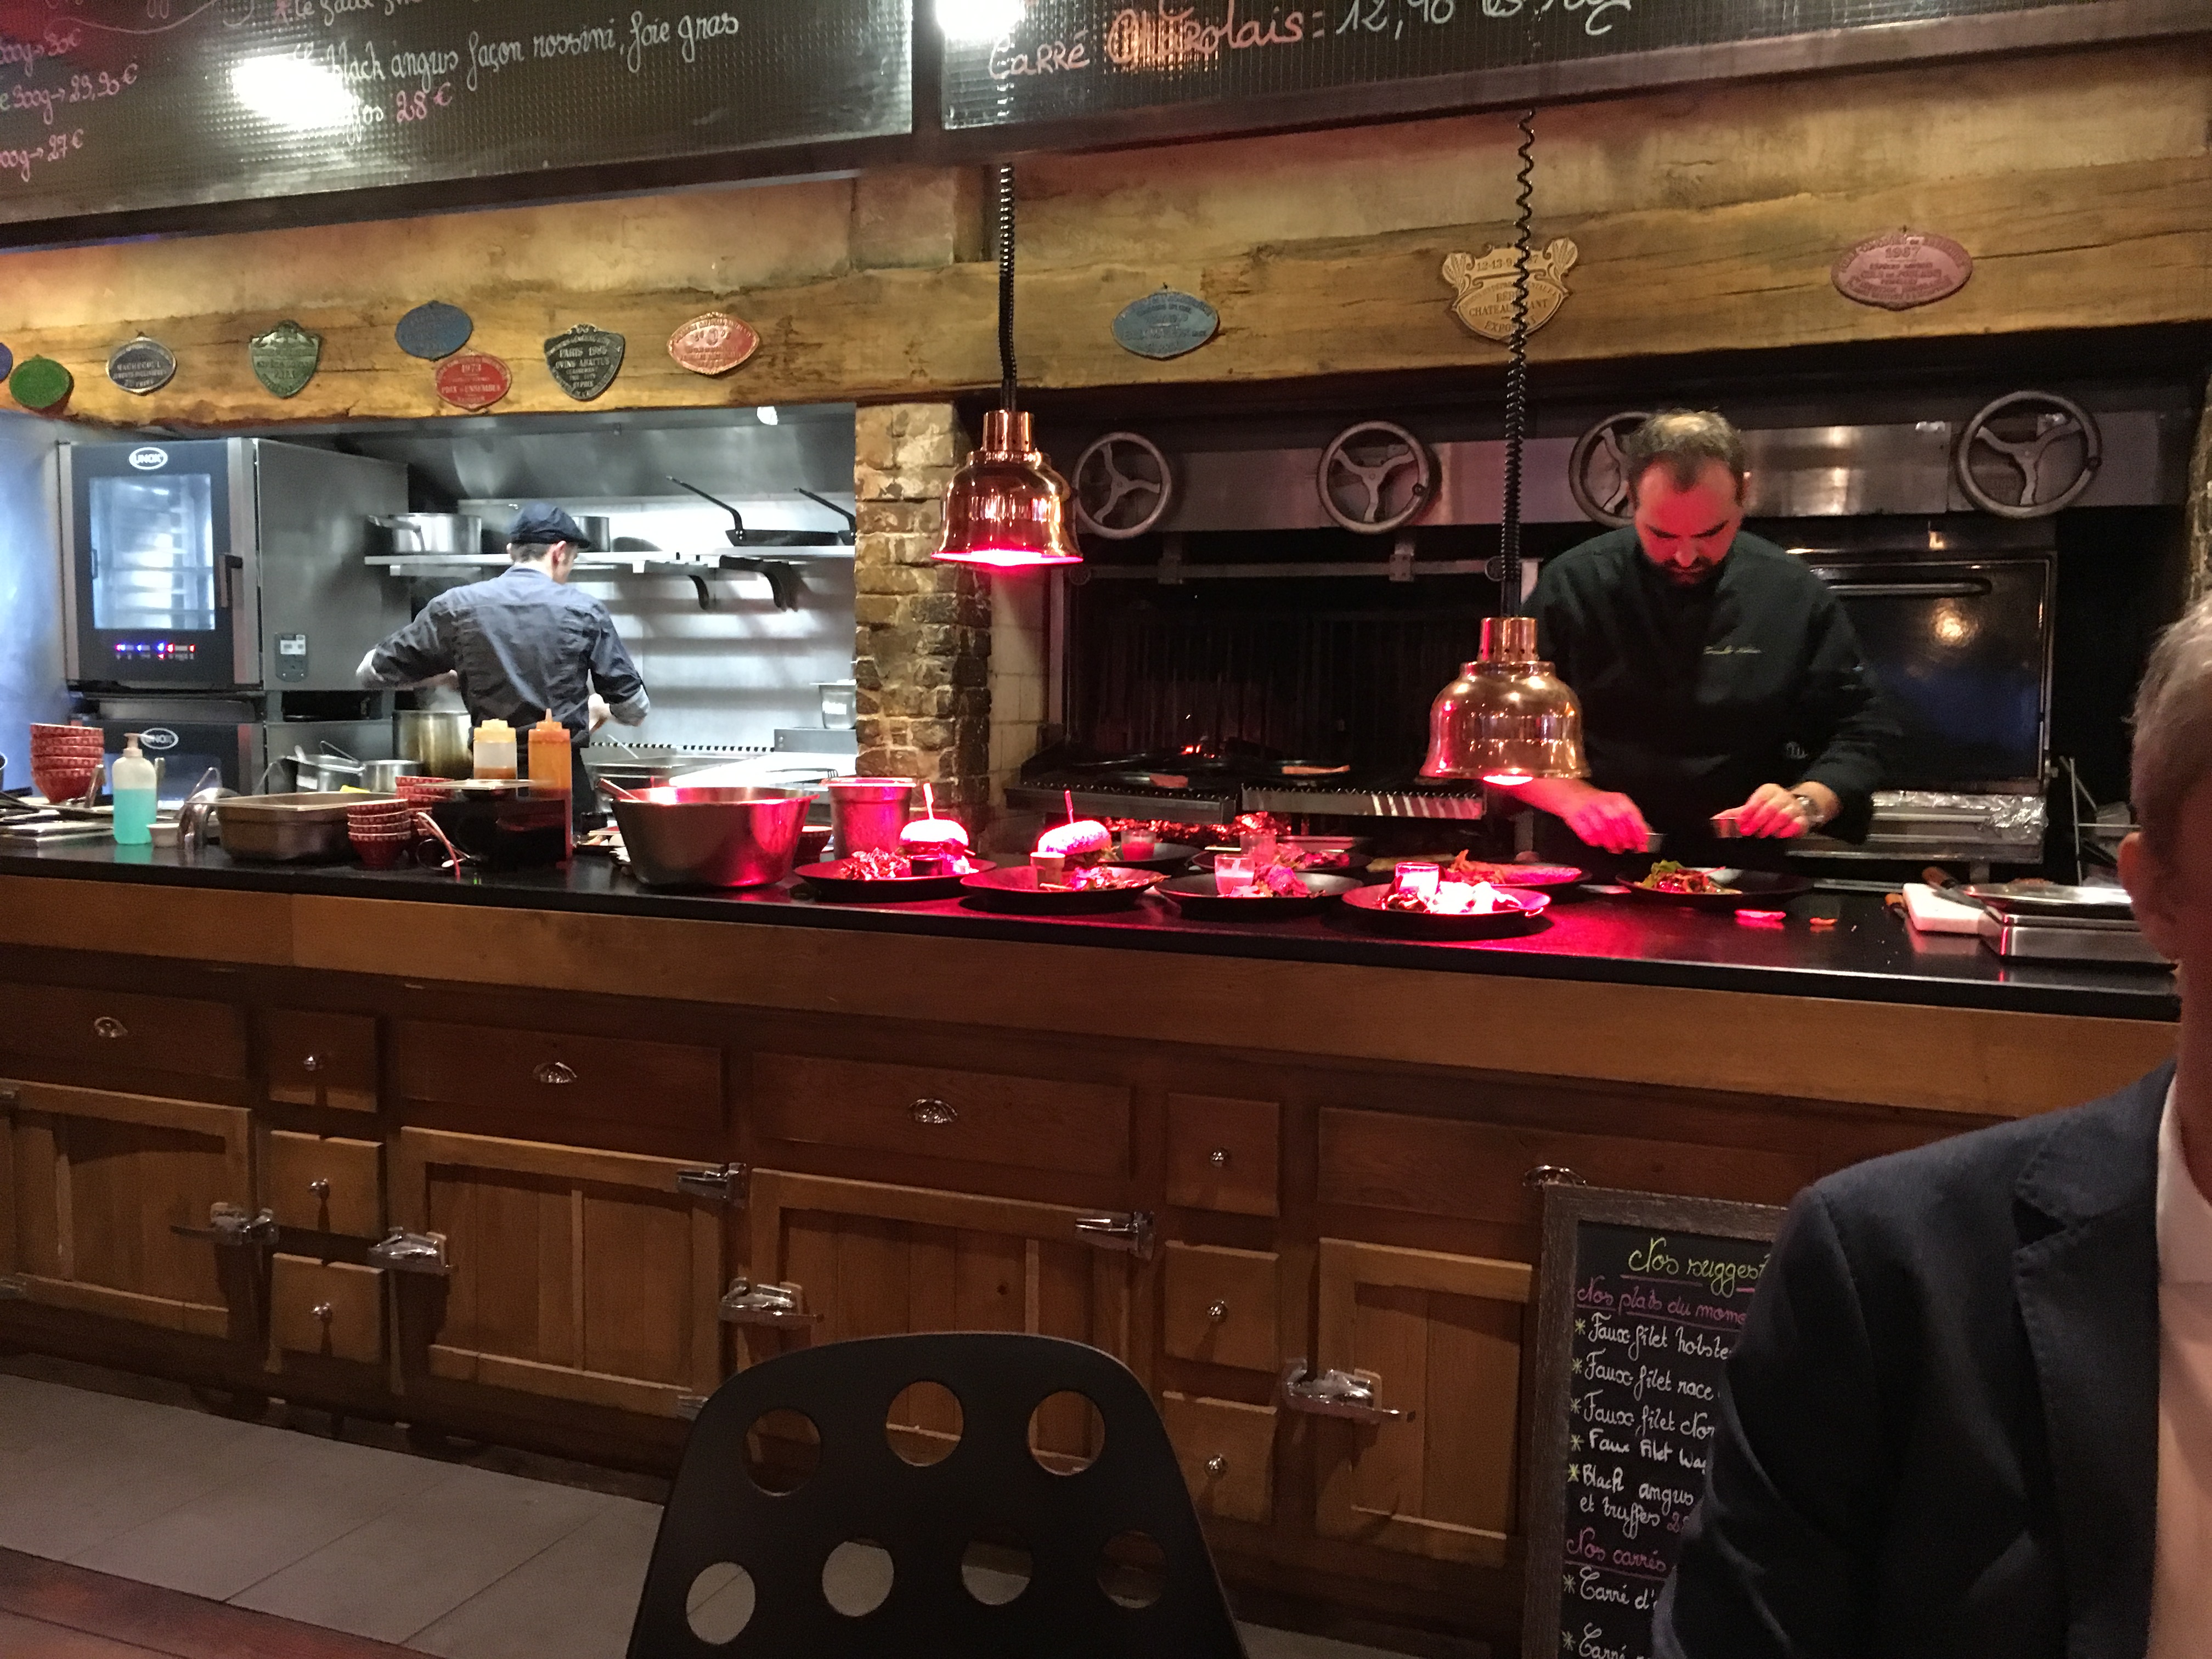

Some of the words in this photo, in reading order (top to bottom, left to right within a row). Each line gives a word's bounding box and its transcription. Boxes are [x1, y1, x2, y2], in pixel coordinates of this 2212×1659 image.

[391, 50, 459, 94] angus
[466, 31, 525, 91] façon
[627, 11, 671, 74] foie
[678, 12, 739, 63] gras
[1618, 1286, 1663, 1316] plats
[1667, 1296, 1691, 1316] du
[1579, 1493, 1595, 1513] et
[1638, 1482, 1695, 1515] angus
